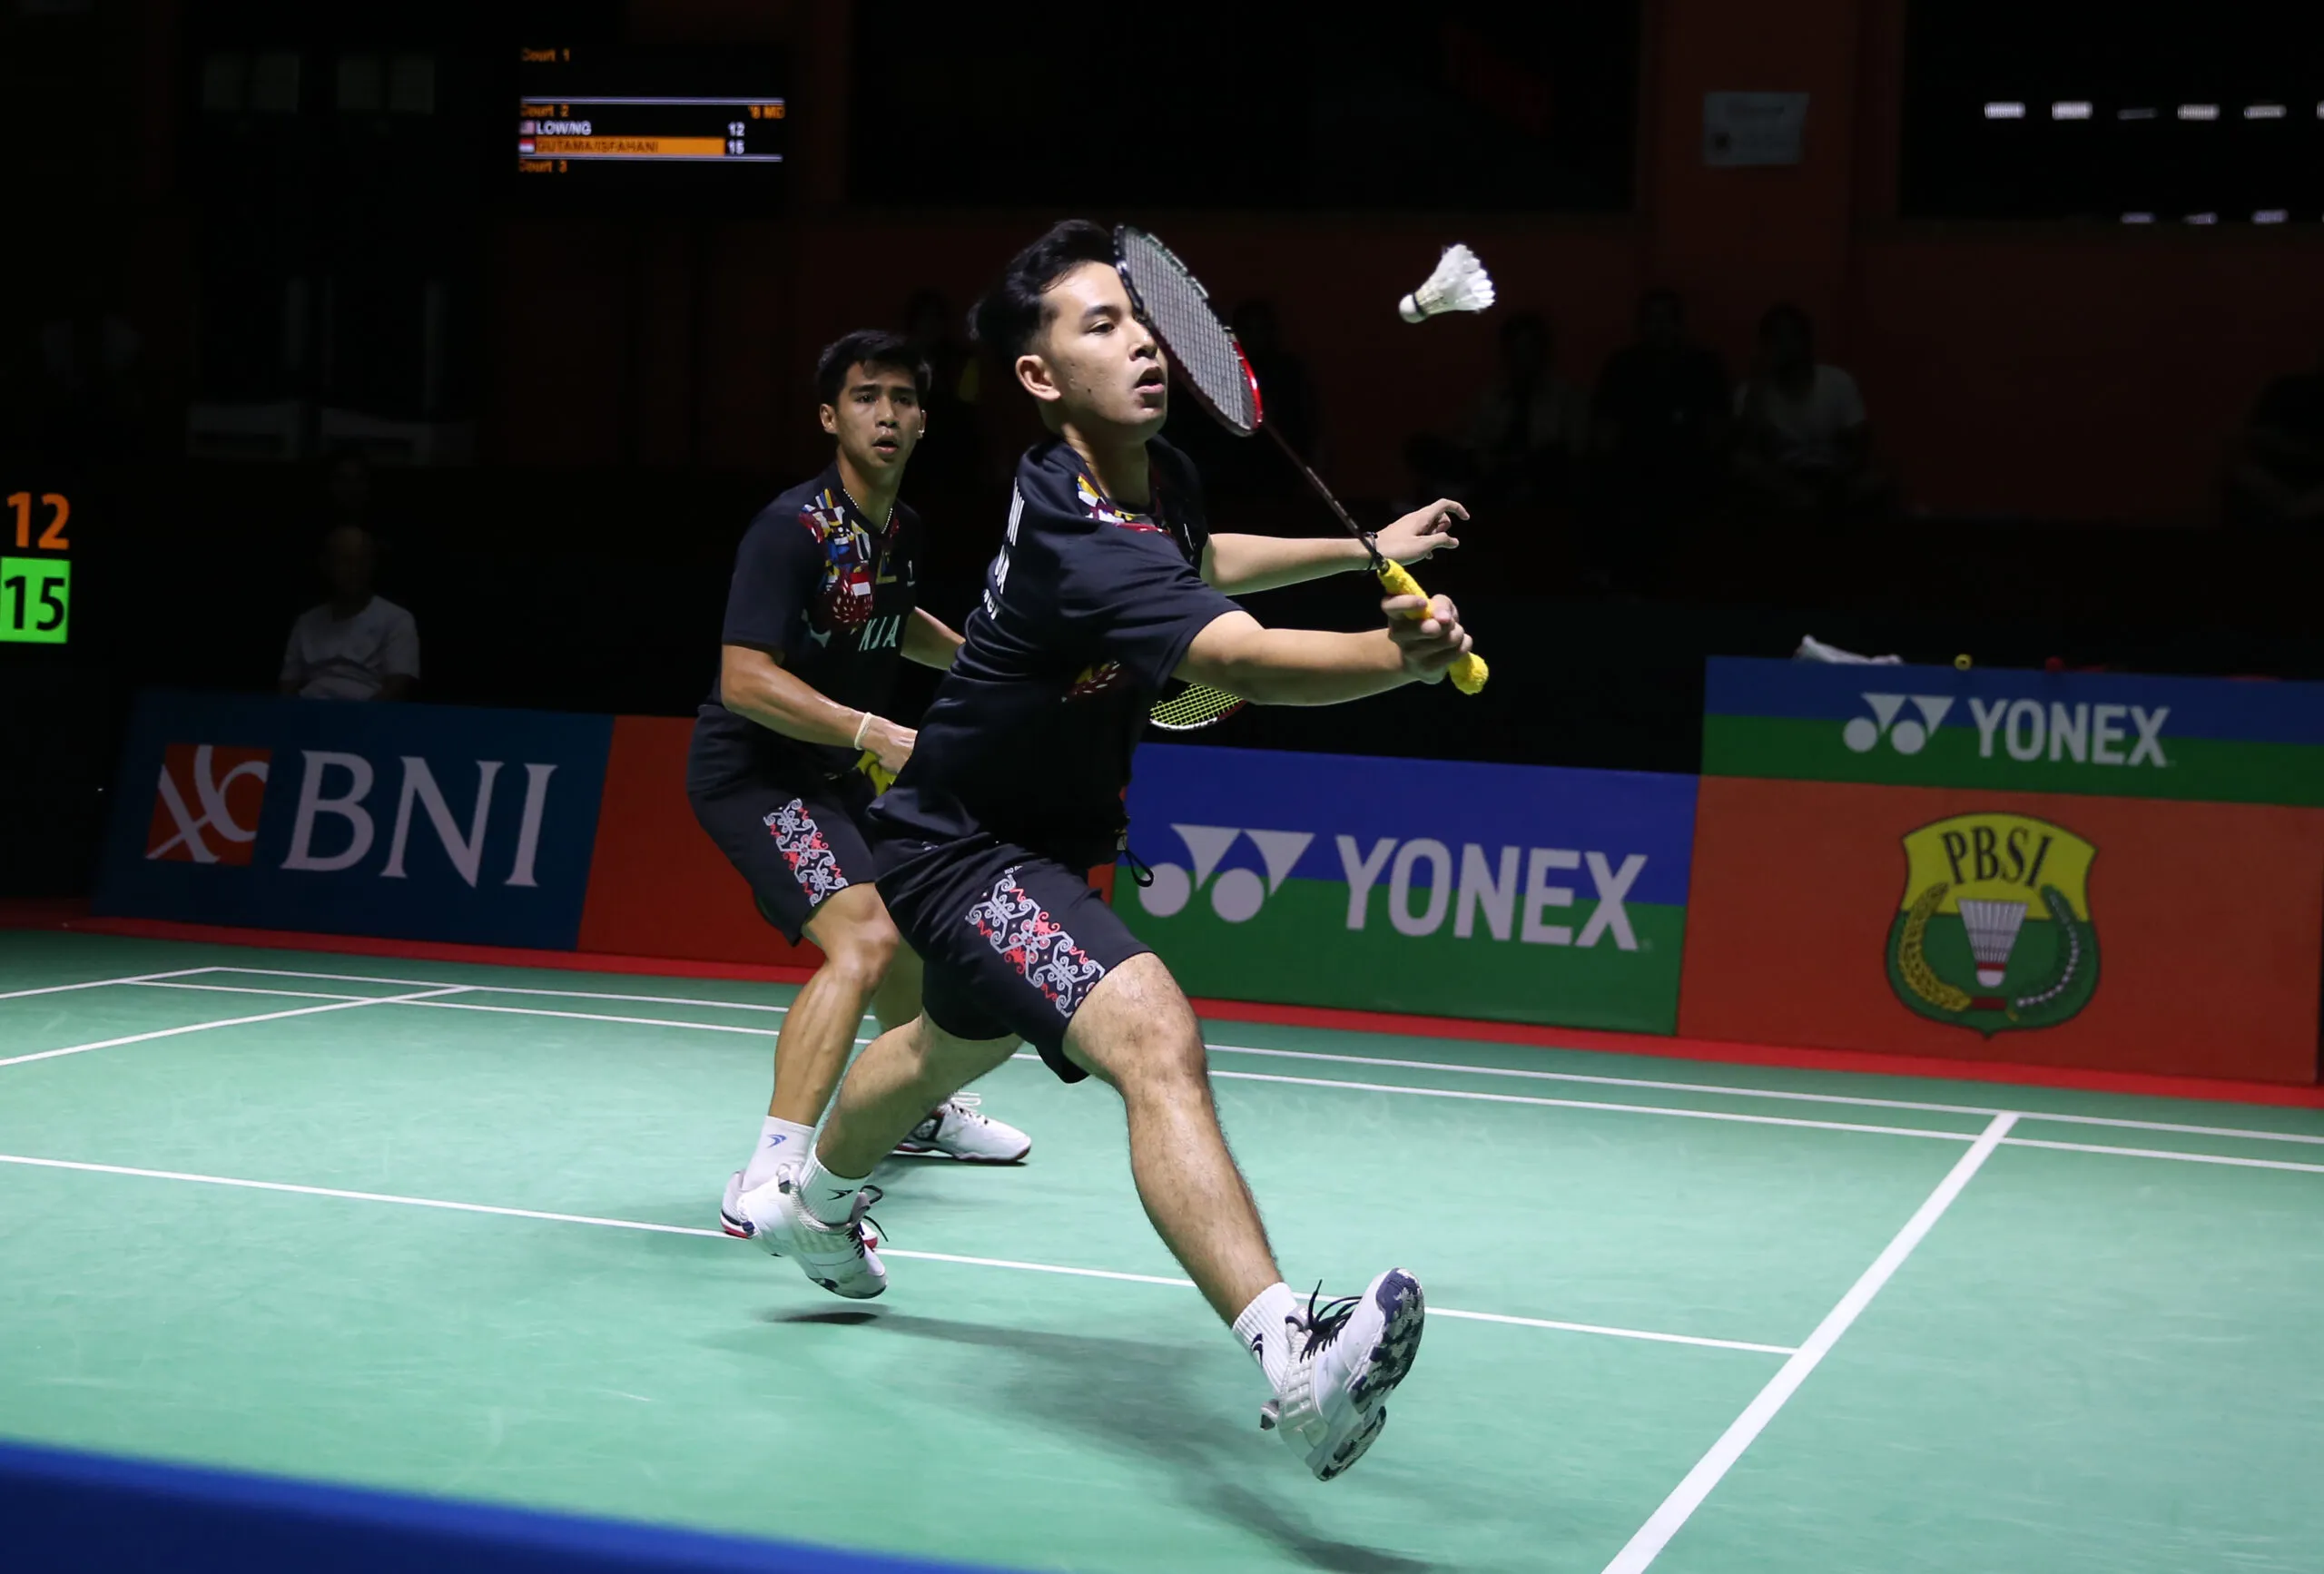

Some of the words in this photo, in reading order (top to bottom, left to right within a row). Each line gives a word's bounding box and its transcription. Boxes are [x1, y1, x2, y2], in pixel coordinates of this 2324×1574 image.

[521, 49, 556, 62] Court
[563, 49, 570, 62] 1
[520, 104, 555, 117] Court
[560, 104, 569, 117] 2
[728, 122, 745, 137] 12
[728, 139, 745, 154] 15
[6, 491, 70, 550] 12
[5, 575, 65, 632] 15
[1967, 696, 2171, 767] YONEX
[280, 749, 558, 889] BNI
[1940, 824, 2053, 887] PBSI
[1335, 834, 1648, 951] YONEX
